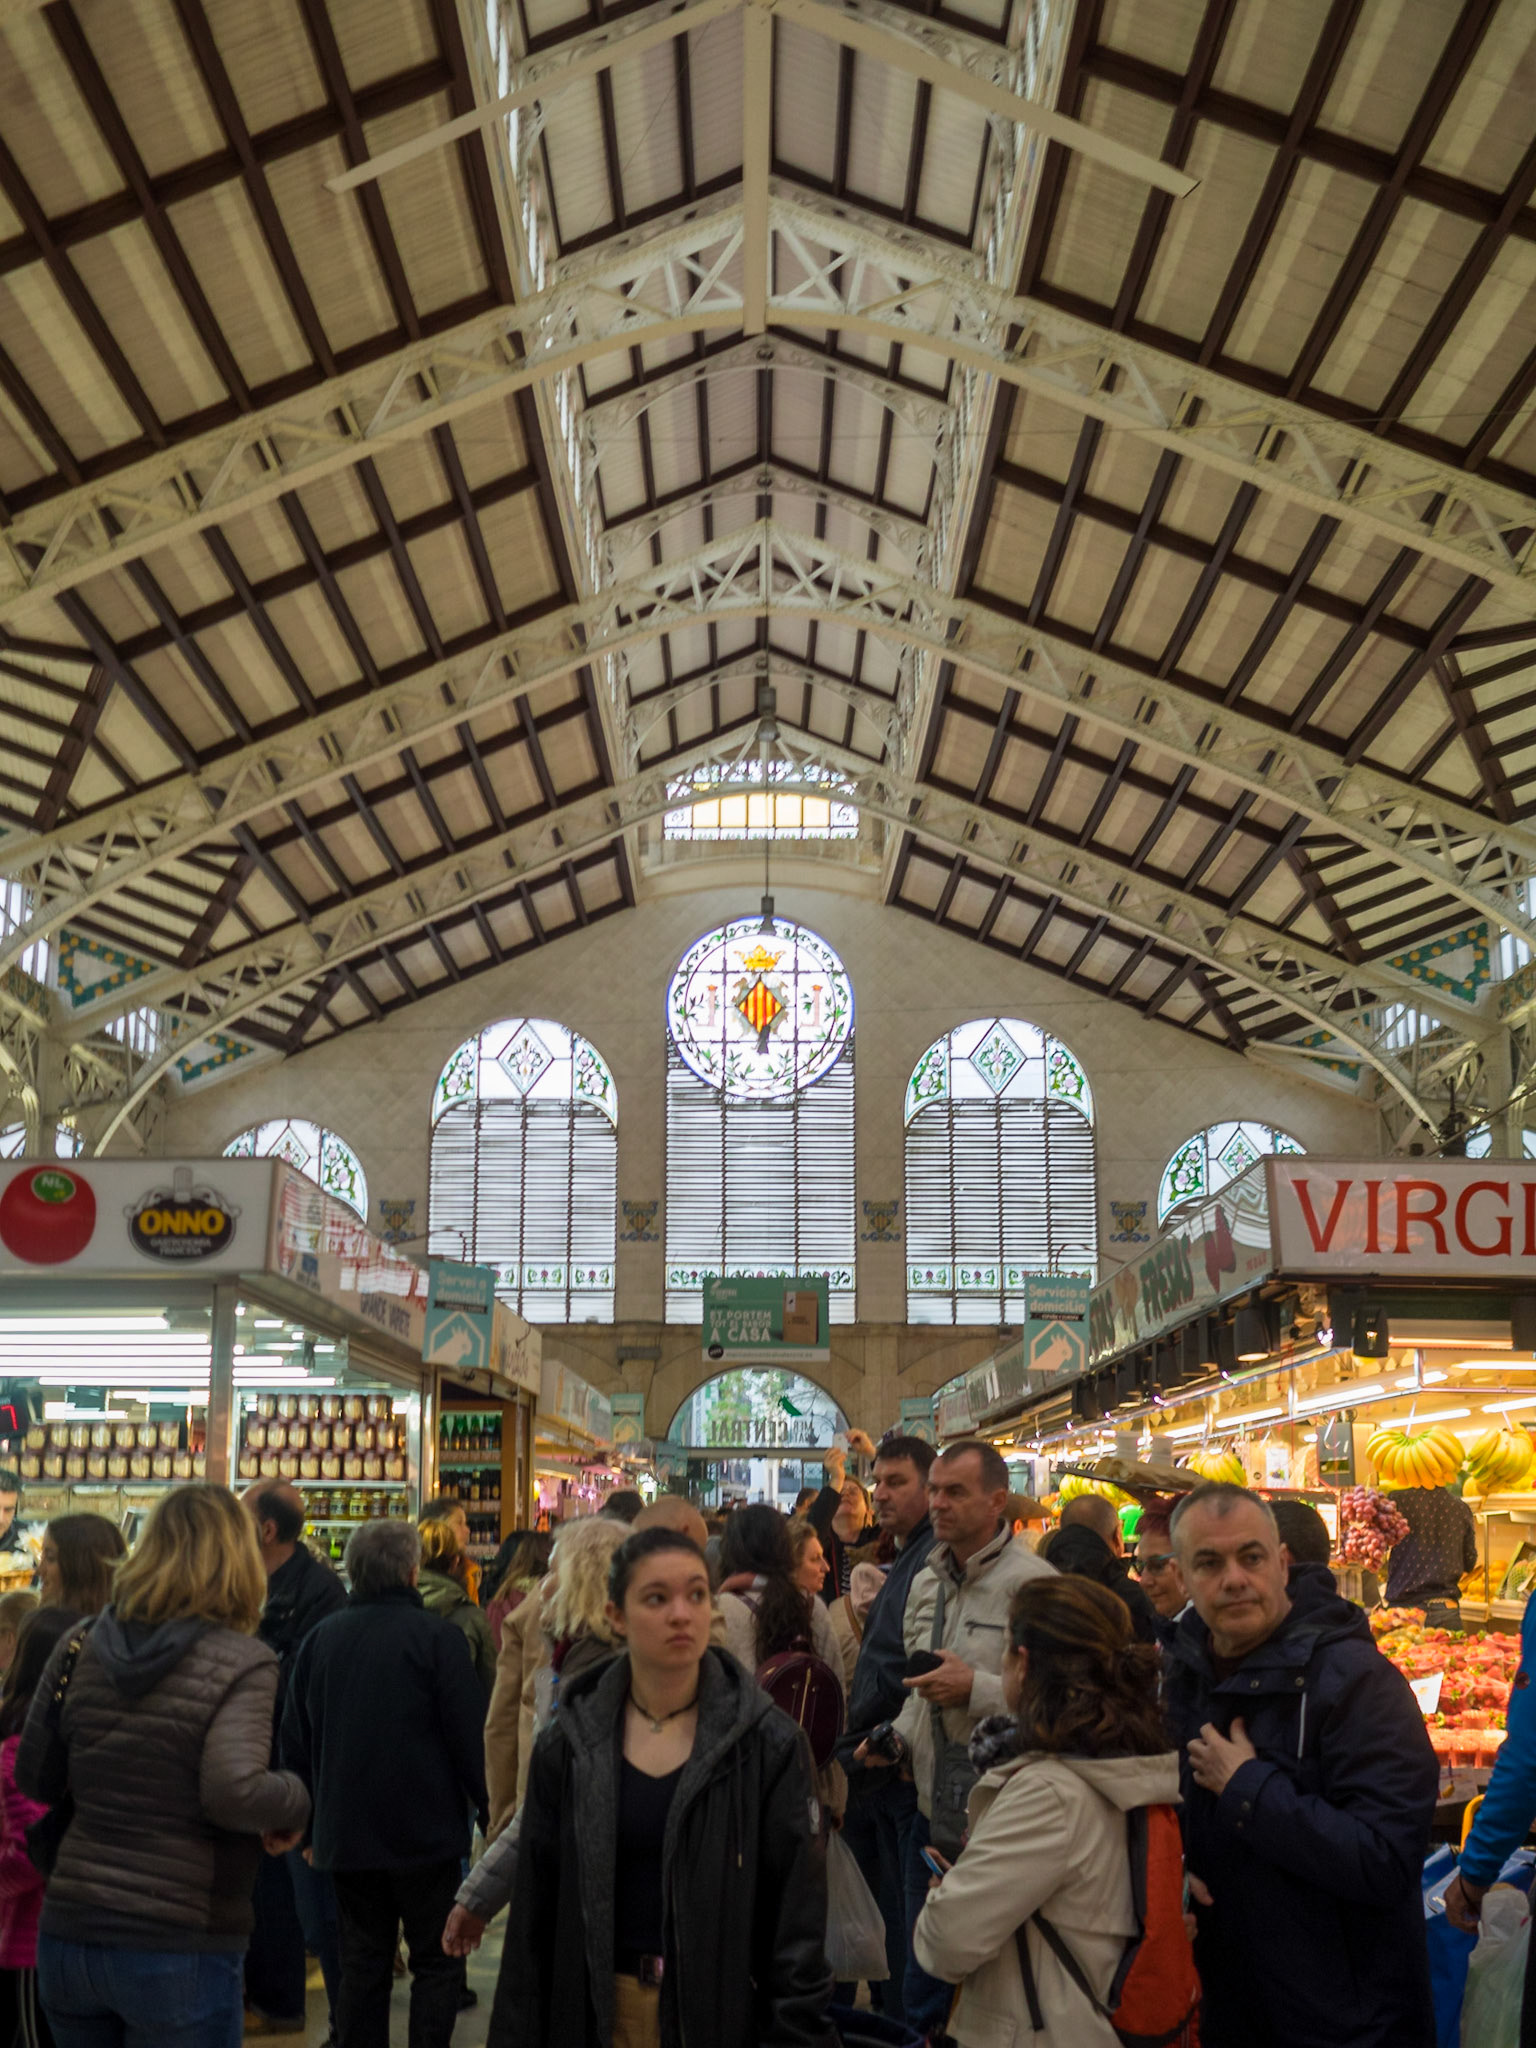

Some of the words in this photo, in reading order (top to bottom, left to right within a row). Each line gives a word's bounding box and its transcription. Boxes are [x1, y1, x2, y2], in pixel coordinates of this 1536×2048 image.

[138, 1208, 226, 1237] ONNO
[1028, 1283, 1077, 1299] Servicio
[1030, 1299, 1086, 1314] domicilio
[709, 1310, 722, 1321] ET
[726, 1310, 772, 1321] PORTEM
[710, 1328, 720, 1342] A
[727, 1328, 771, 1342] CASA
